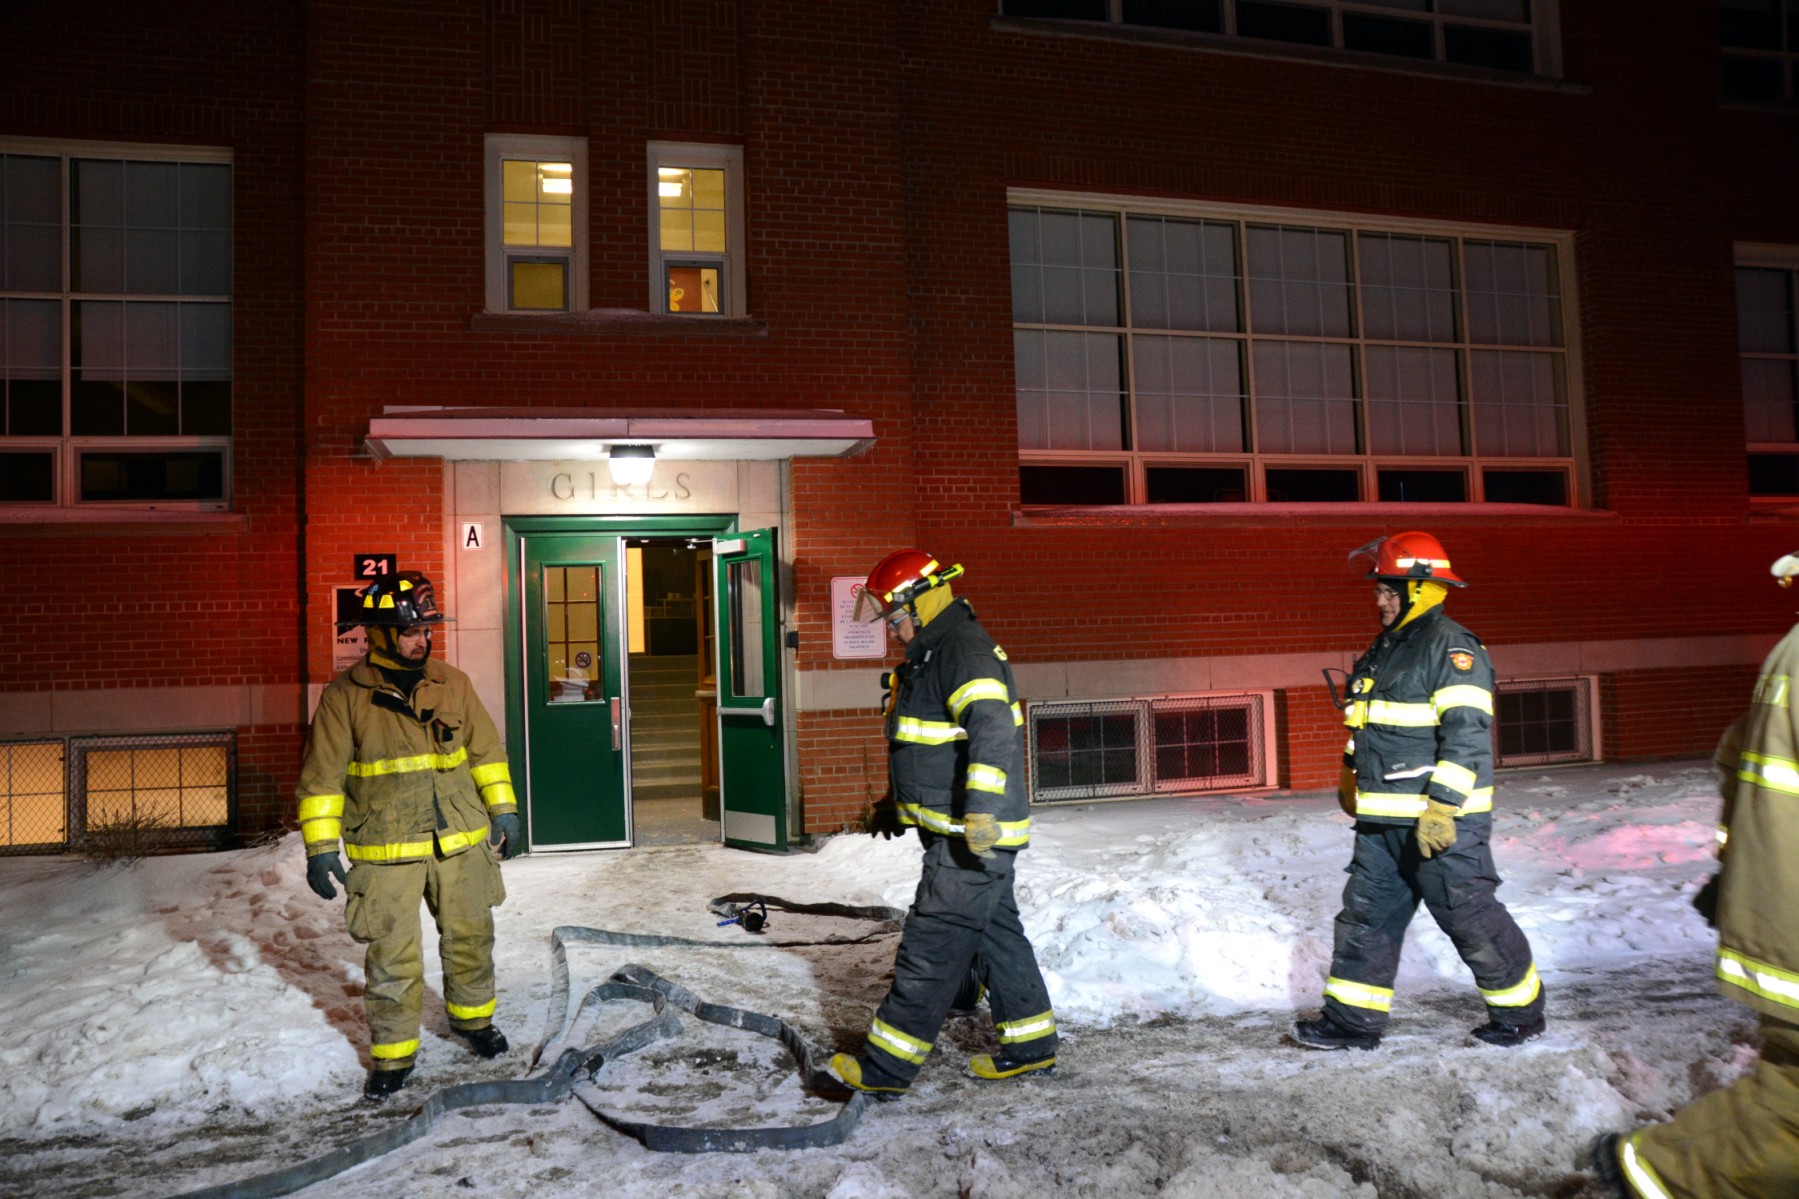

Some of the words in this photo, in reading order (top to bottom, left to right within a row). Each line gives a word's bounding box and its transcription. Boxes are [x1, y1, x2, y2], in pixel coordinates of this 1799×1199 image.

[550, 471, 692, 501] GIRLS
[466, 525, 480, 547] A
[362, 559, 388, 576] 21
